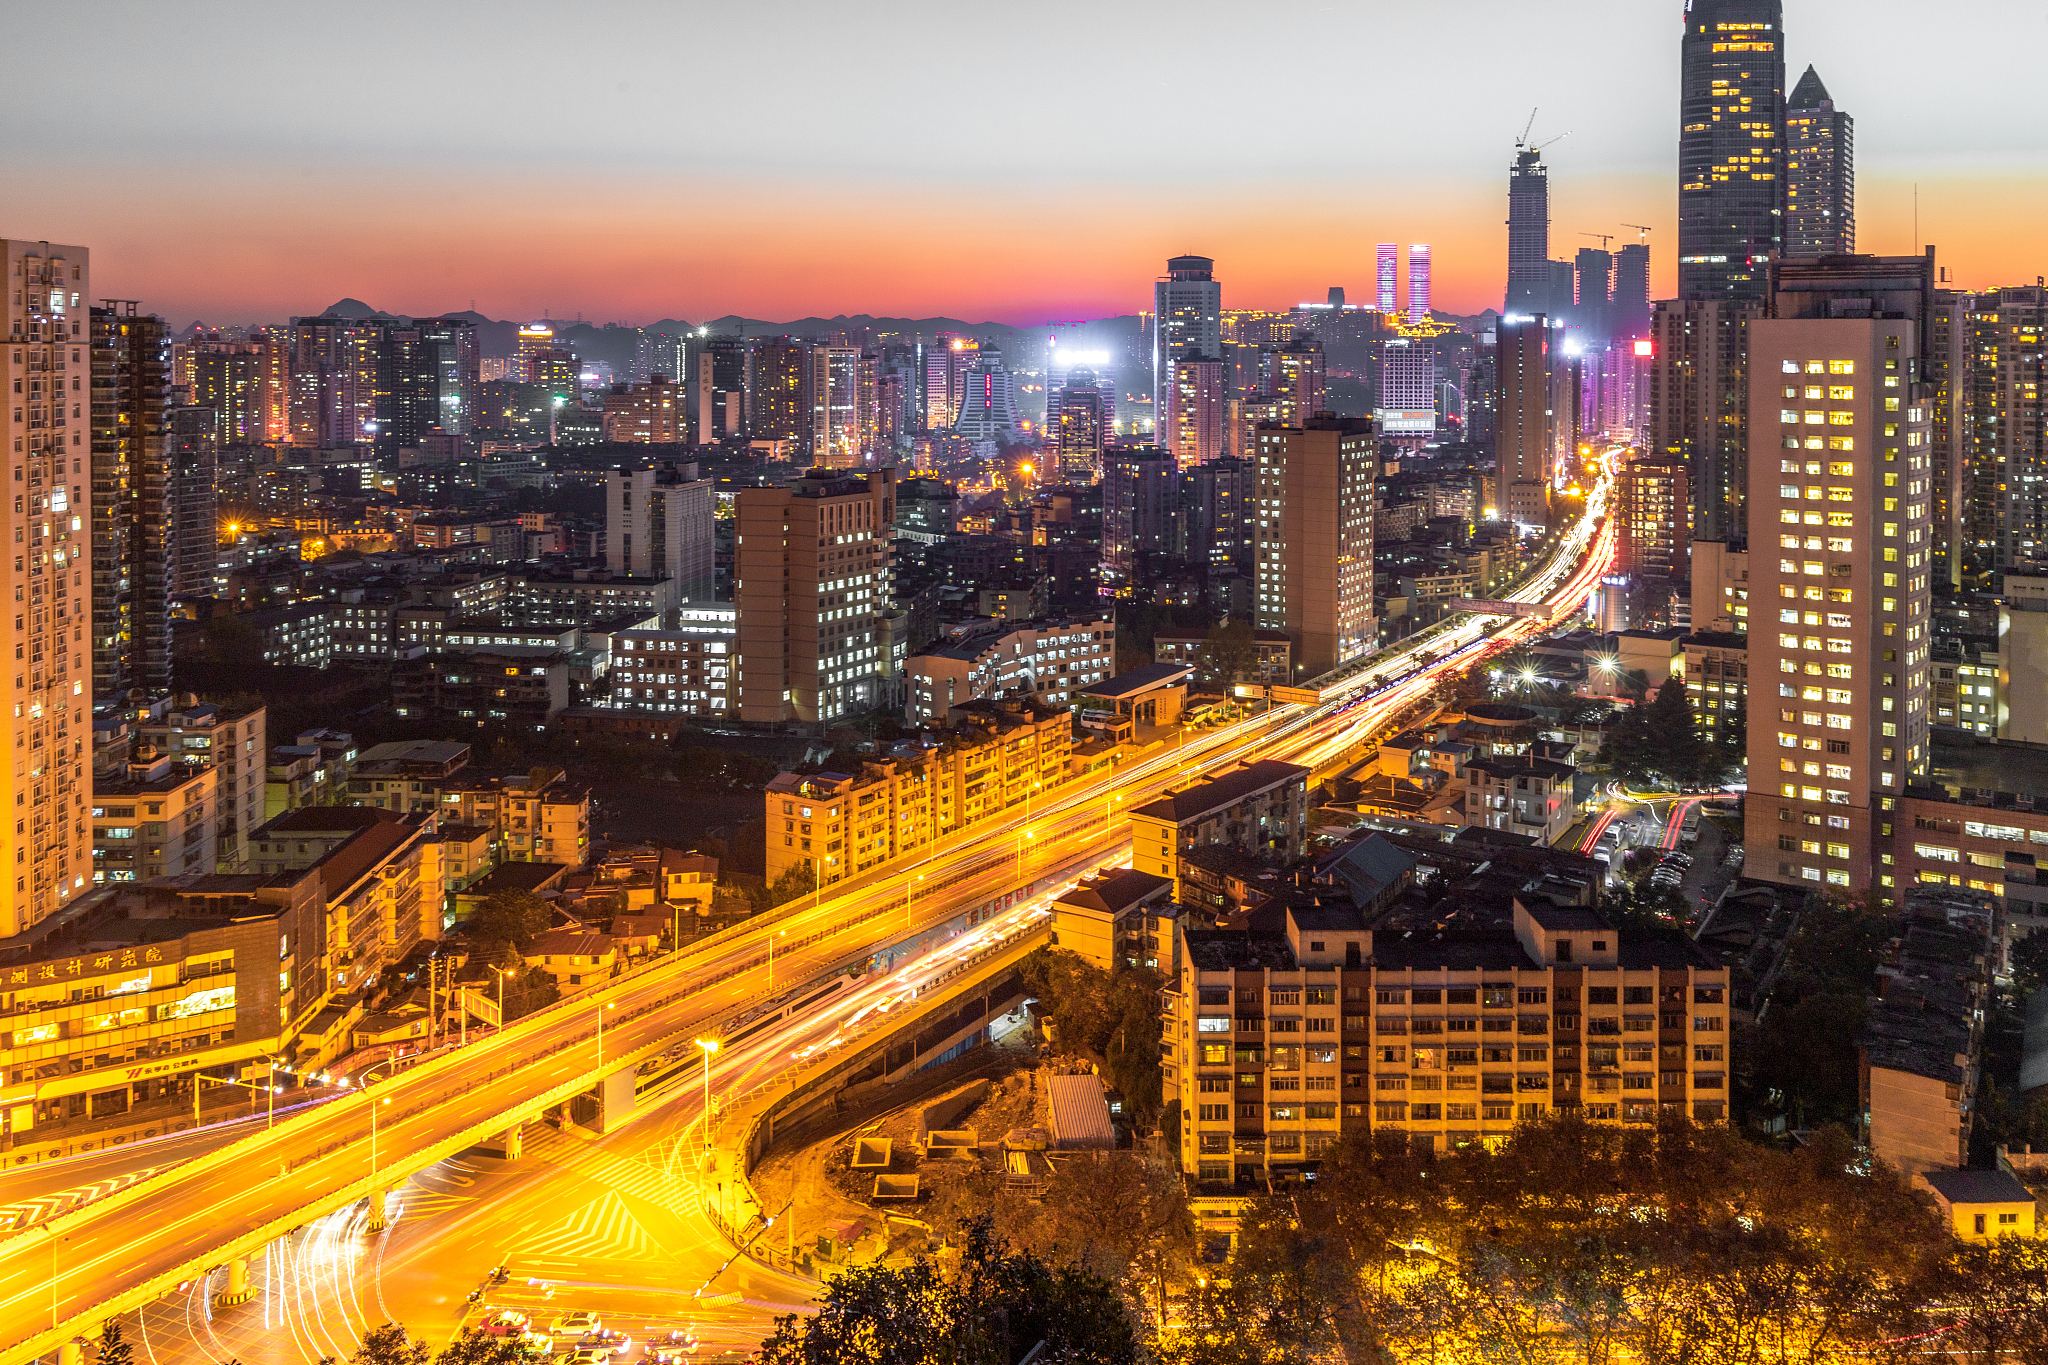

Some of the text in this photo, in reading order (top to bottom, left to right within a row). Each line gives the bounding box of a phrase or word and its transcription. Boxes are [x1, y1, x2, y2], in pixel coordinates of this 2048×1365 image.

[0, 946, 163, 986] 测设计研究院
